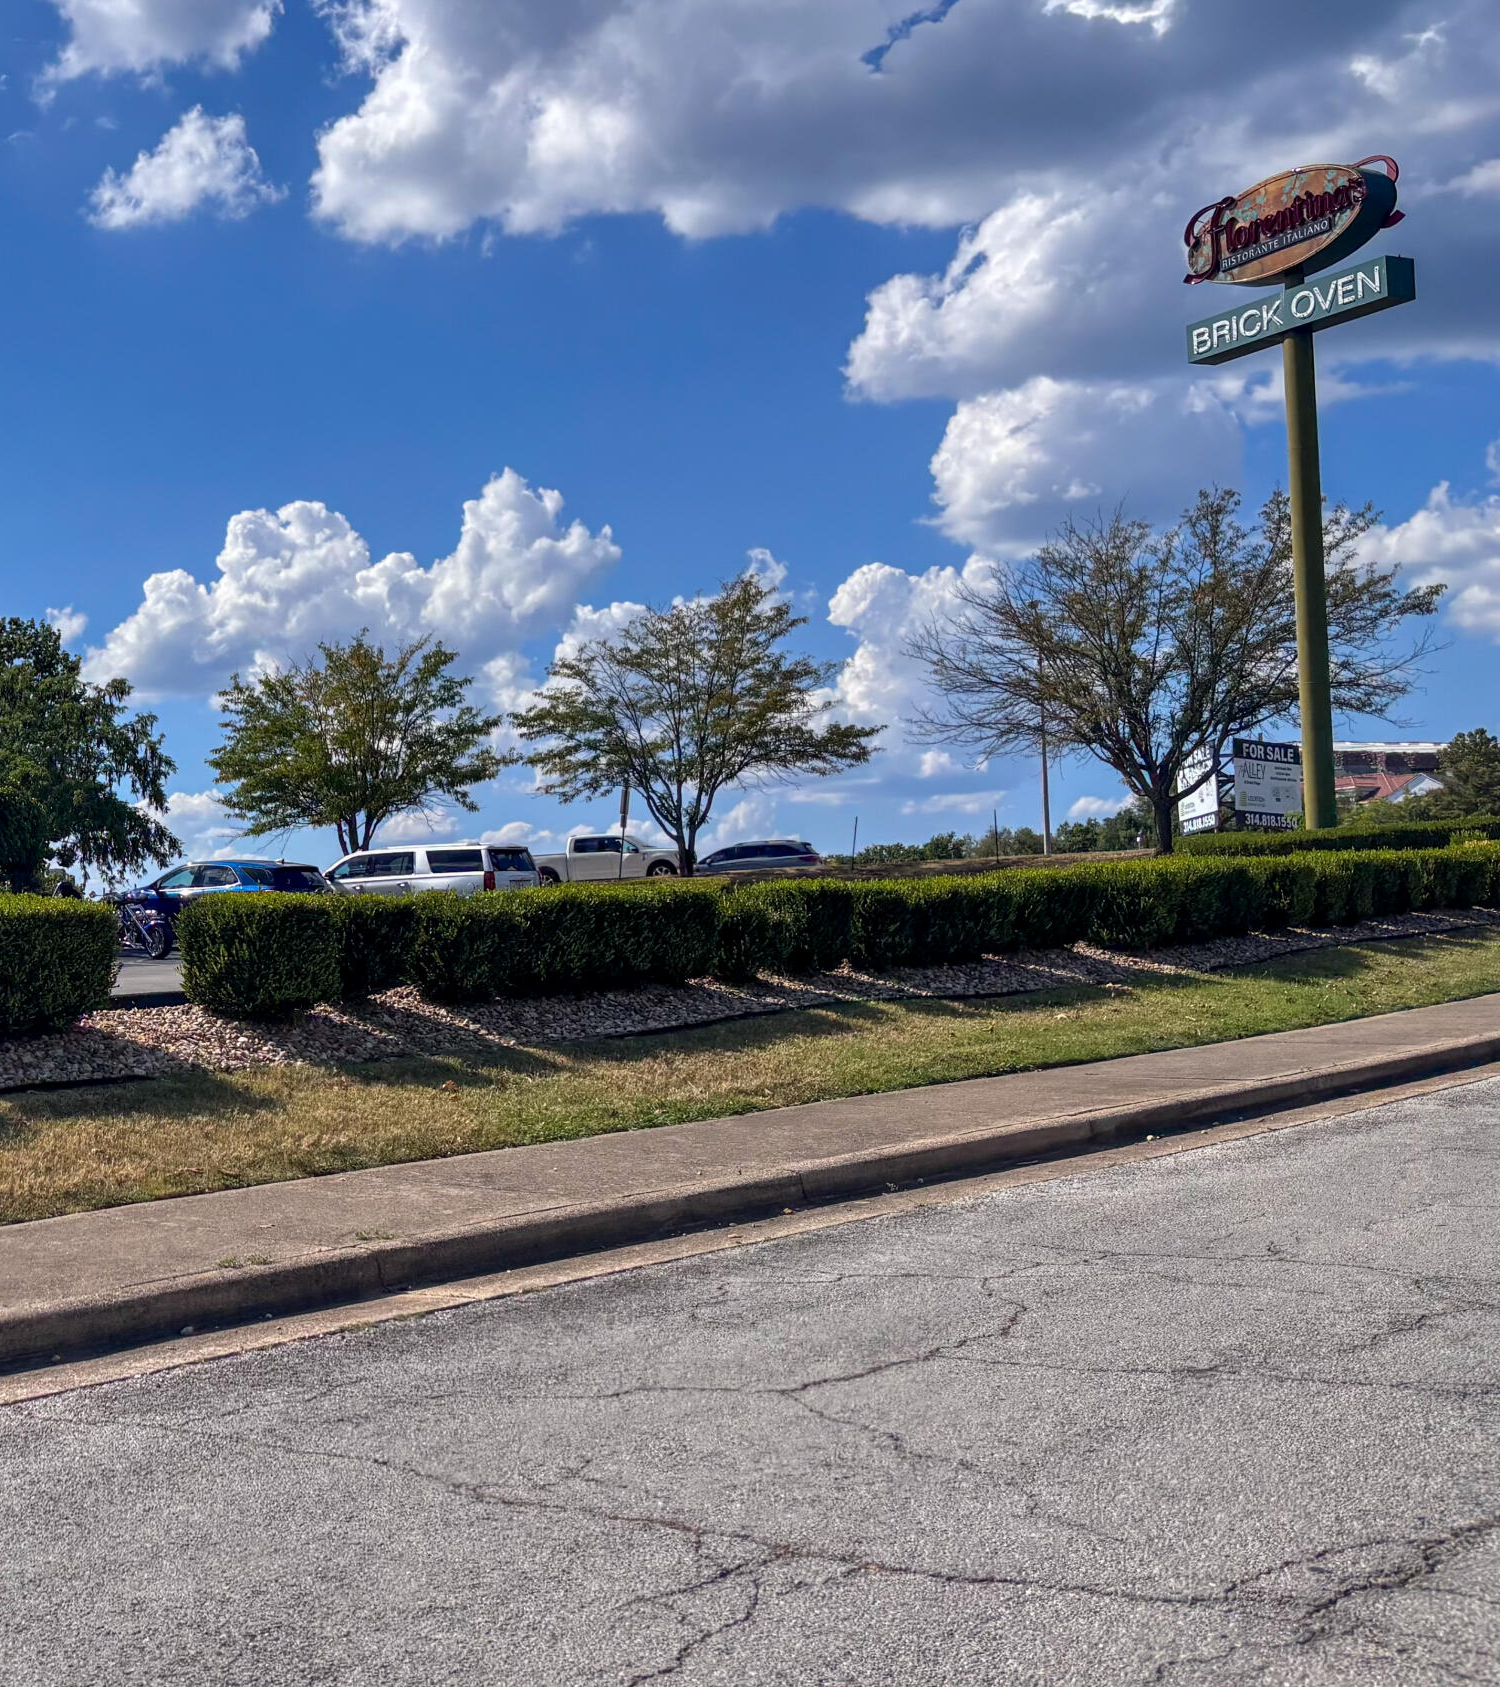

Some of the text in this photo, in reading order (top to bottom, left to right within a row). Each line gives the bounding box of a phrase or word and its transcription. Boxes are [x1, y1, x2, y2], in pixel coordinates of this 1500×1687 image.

[1222, 220, 1329, 269] RISTORANTE ITALIANO
[1193, 265, 1380, 355] BRICK OVEN
[1242, 743, 1294, 763] FOR SALE
[1243, 761, 1266, 779] ALLEY
[1245, 813, 1298, 828] 314.818.1550
